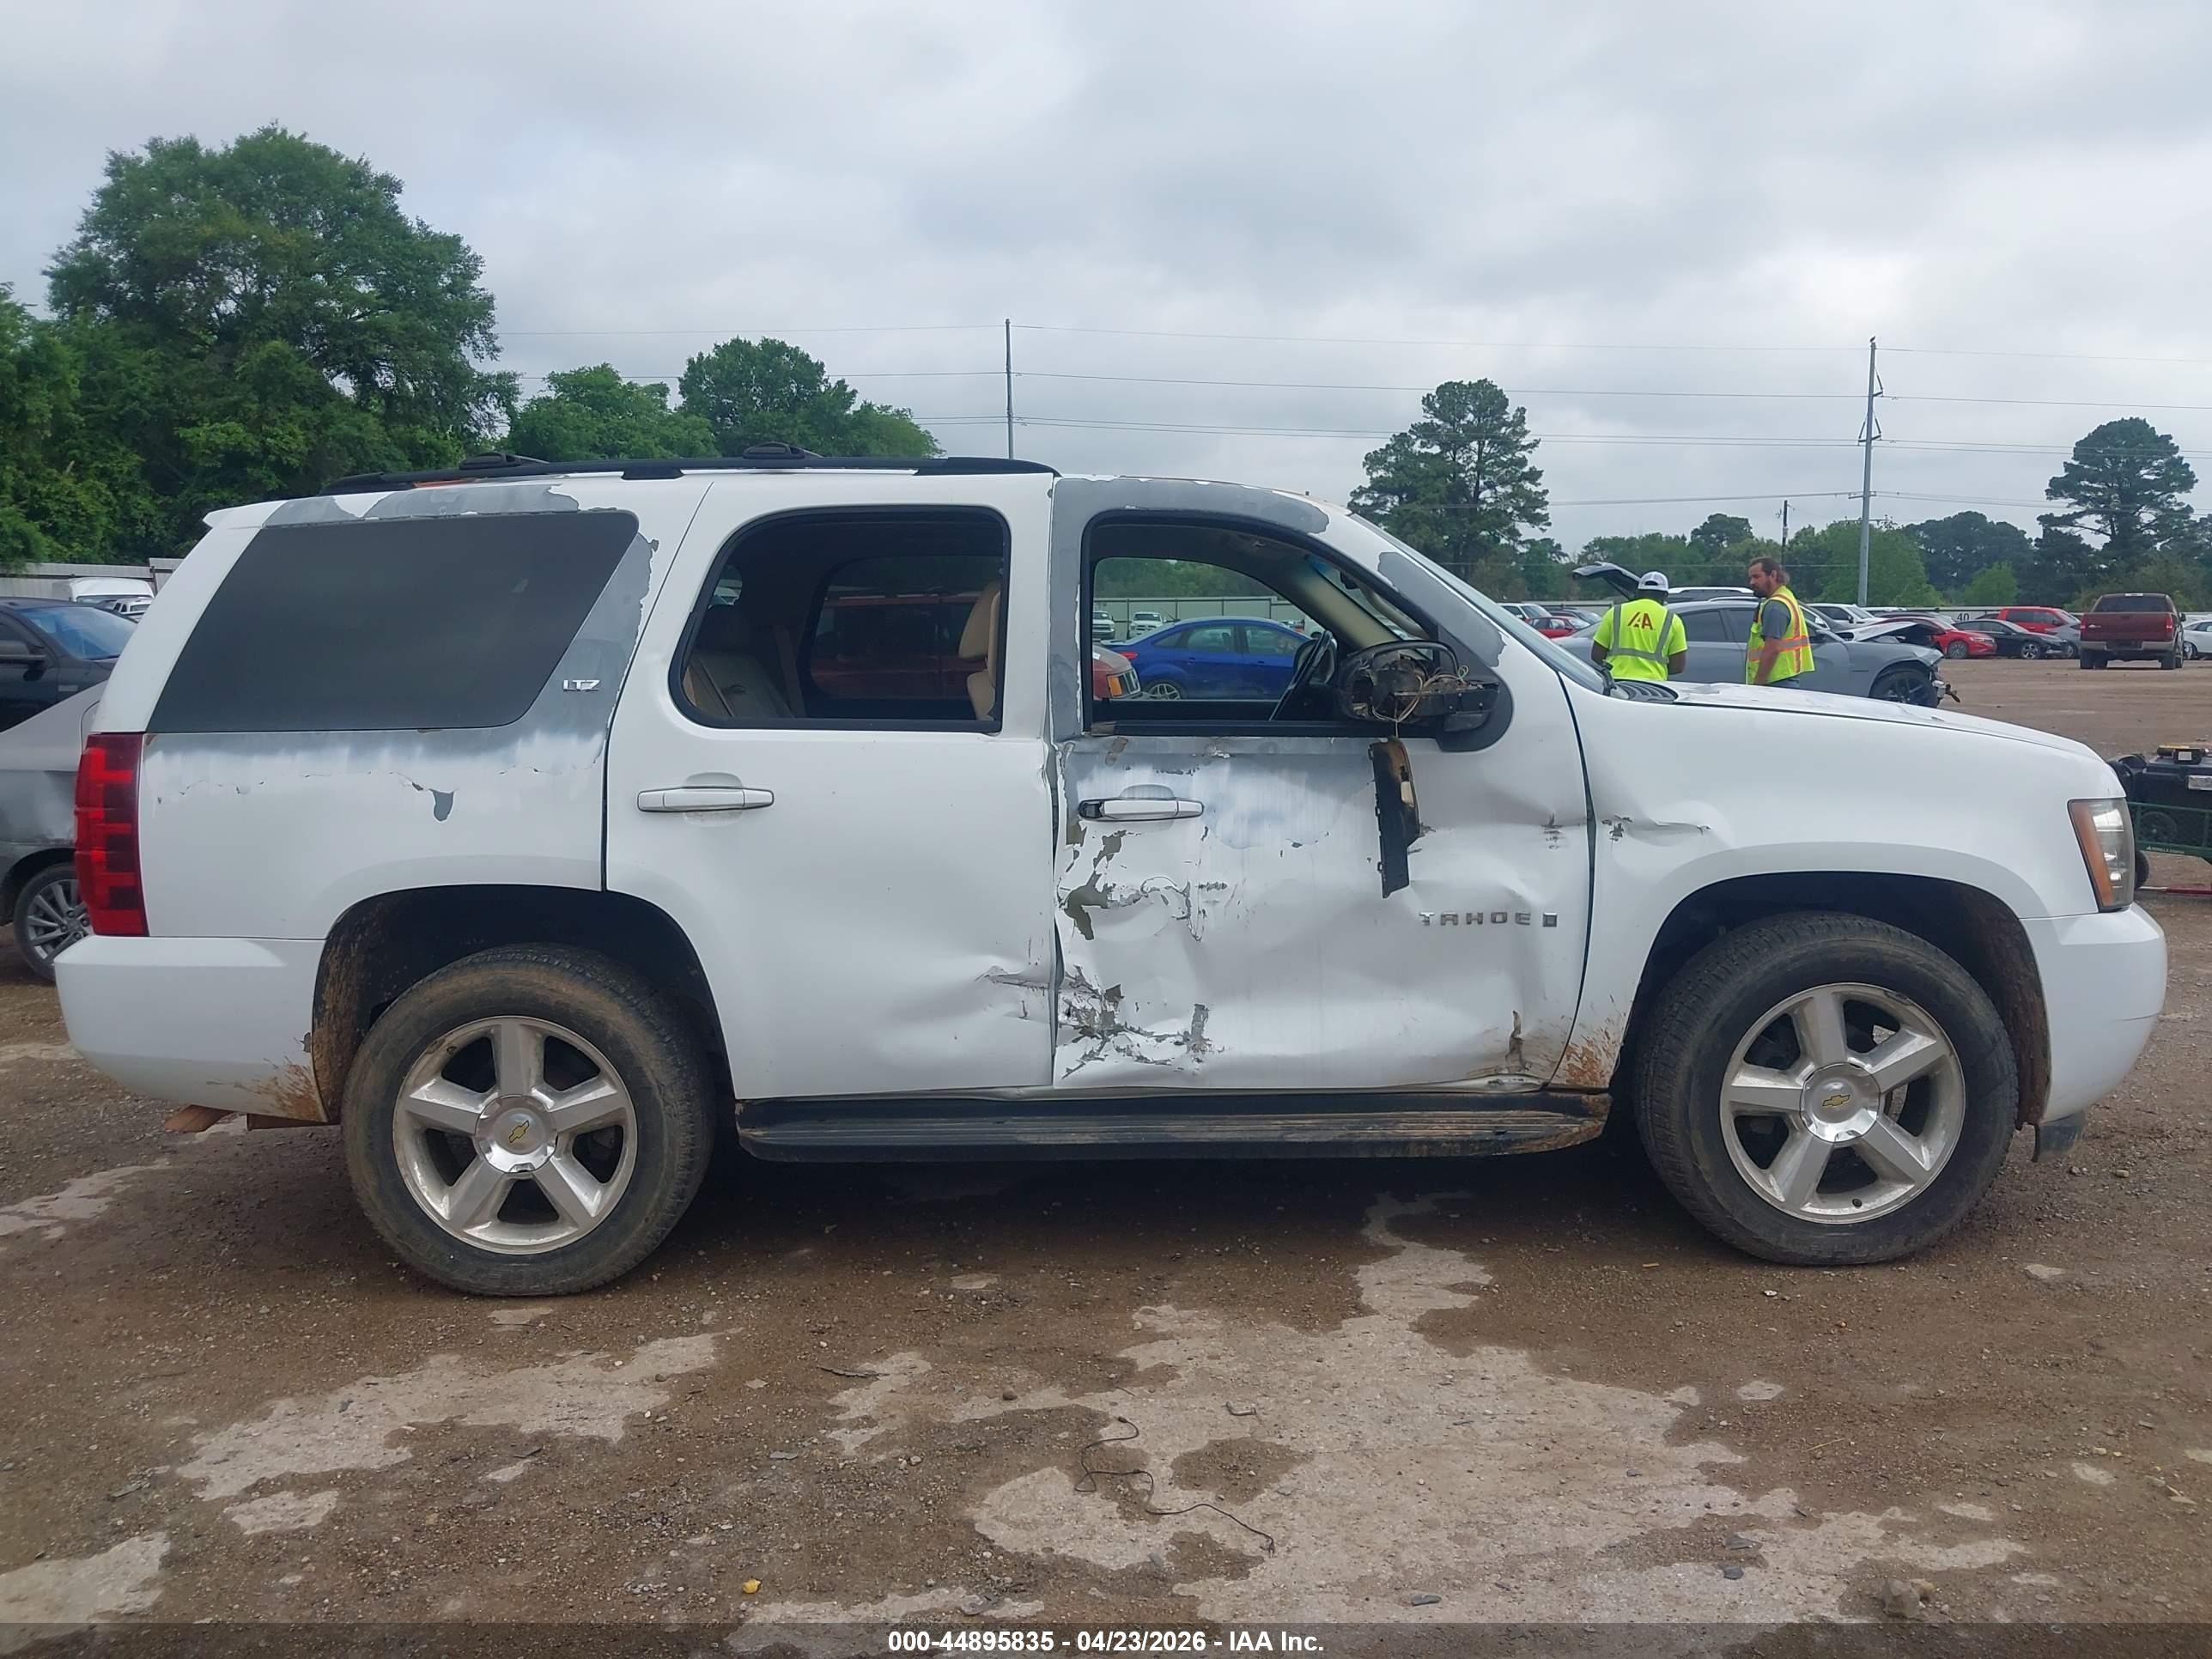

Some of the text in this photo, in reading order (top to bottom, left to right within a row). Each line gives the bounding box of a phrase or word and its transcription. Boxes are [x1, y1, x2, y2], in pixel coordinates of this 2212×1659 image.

[1957, 612, 1969, 621] 40
[563, 679, 600, 691] LTZ
[1419, 911, 1532, 927] TAHOE
